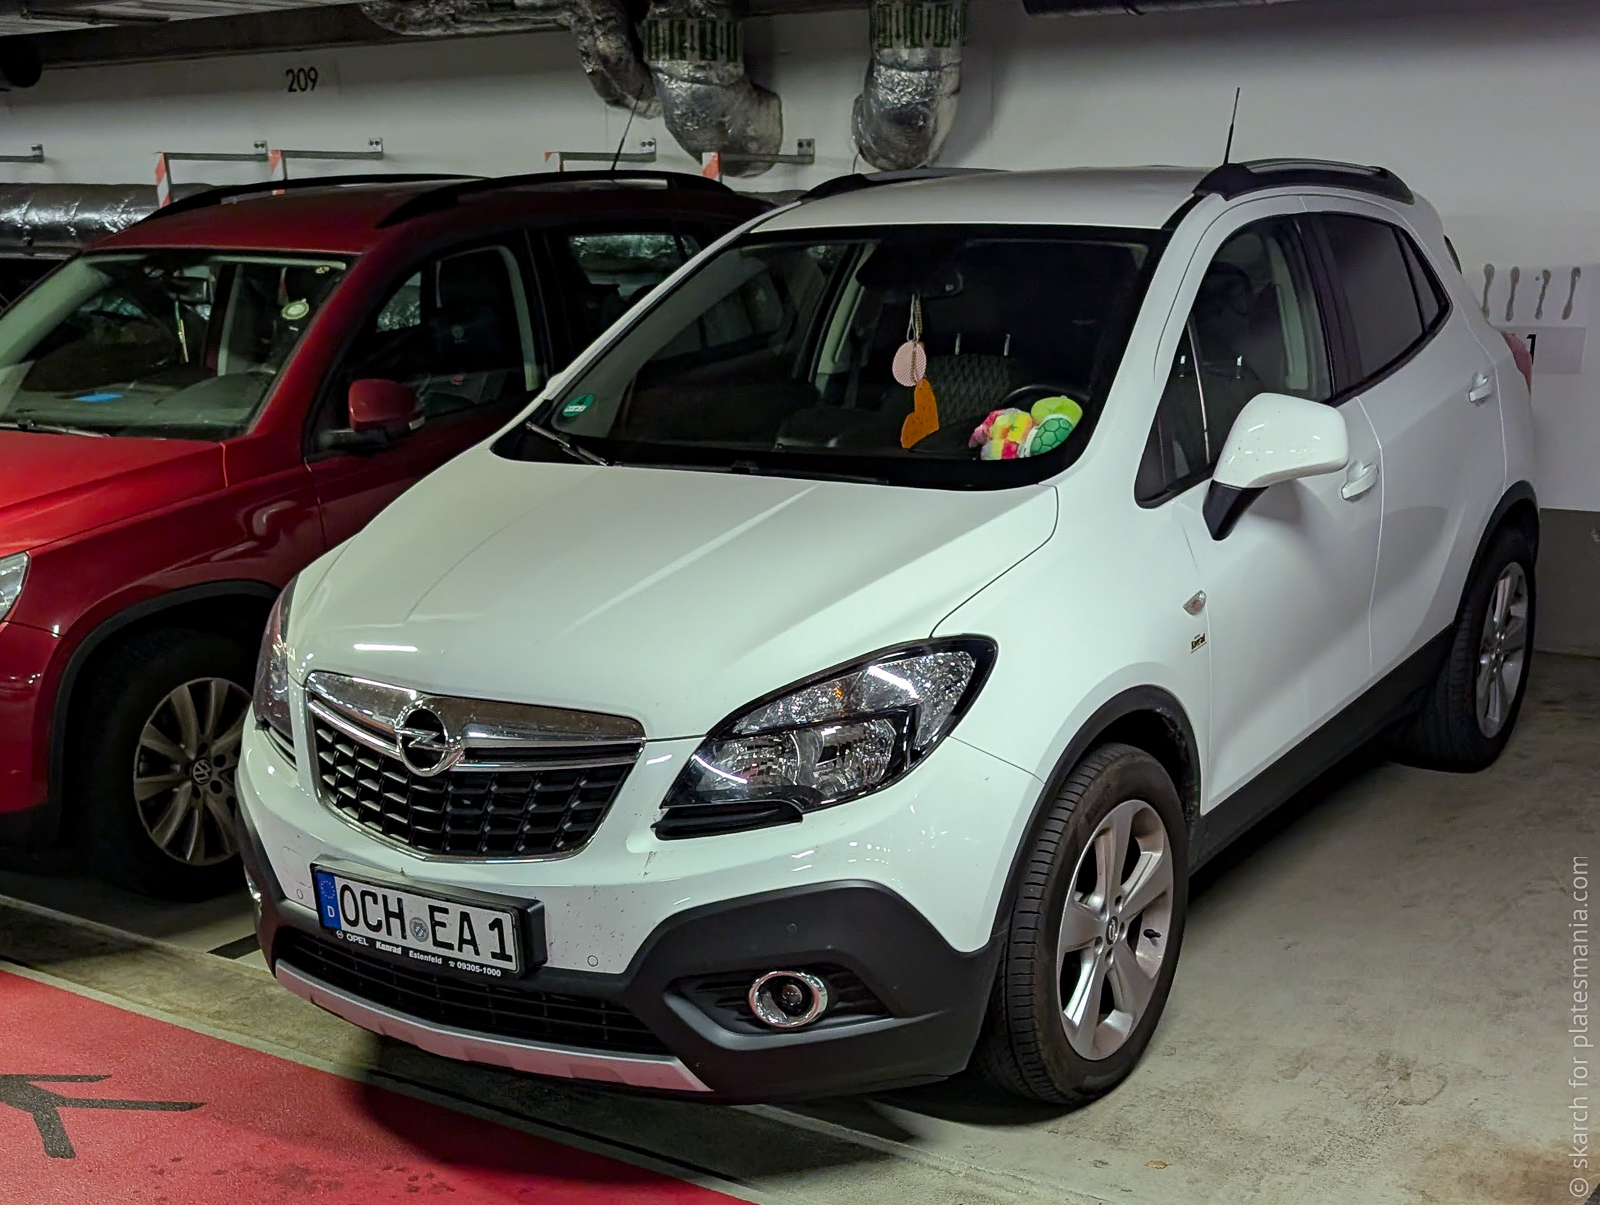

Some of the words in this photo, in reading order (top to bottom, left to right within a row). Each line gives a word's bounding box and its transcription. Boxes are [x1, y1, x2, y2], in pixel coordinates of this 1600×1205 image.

[285, 66, 318, 92] 209
[327, 905, 335, 918] D
[339, 884, 407, 940] OCH
[428, 904, 480, 956] EA
[488, 917, 513, 963] 1
[346, 933, 369, 947] OPEL
[408, 950, 443, 965] Estenfeld
[456, 961, 502, 977] 09305-1000
